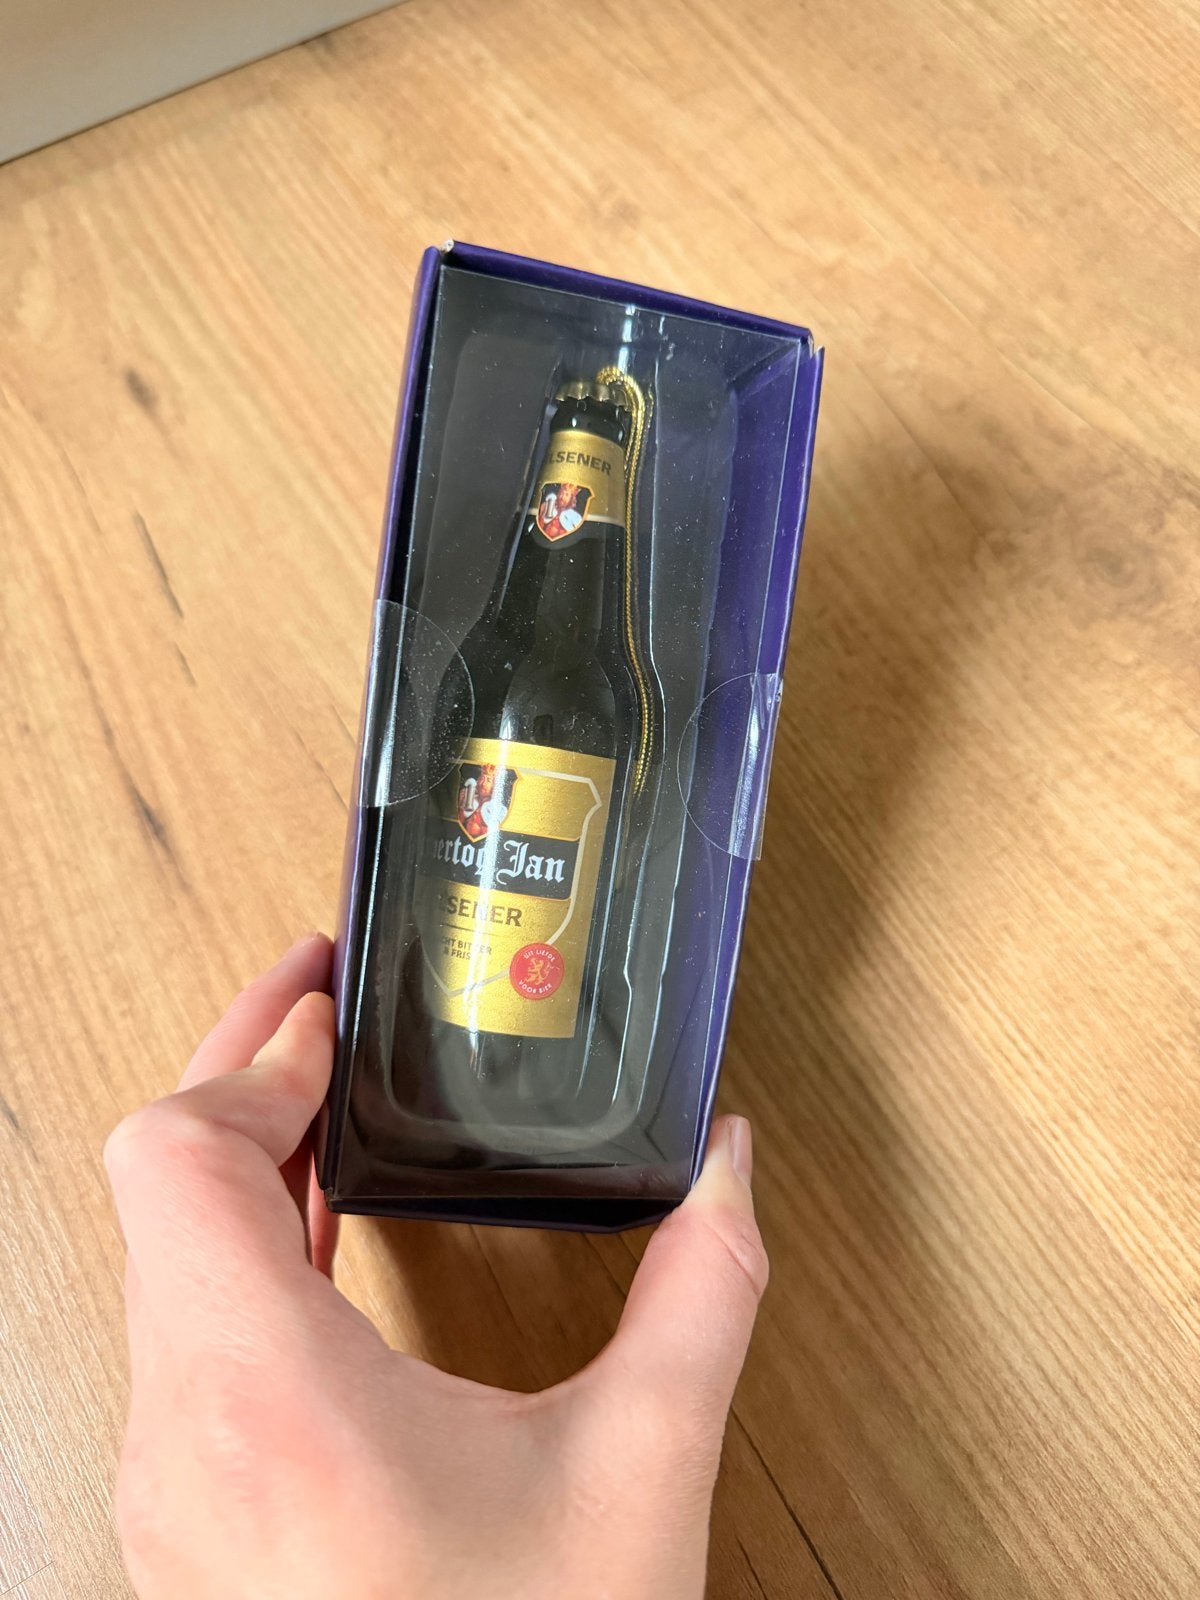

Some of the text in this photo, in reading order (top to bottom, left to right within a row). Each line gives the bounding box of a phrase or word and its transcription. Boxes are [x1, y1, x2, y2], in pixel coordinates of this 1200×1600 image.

[496, 840, 566, 886] Jan
[458, 940, 492, 955] BITER
[523, 949, 556, 963] UIT LIEFDE
[518, 980, 553, 994] VOOR BIER
